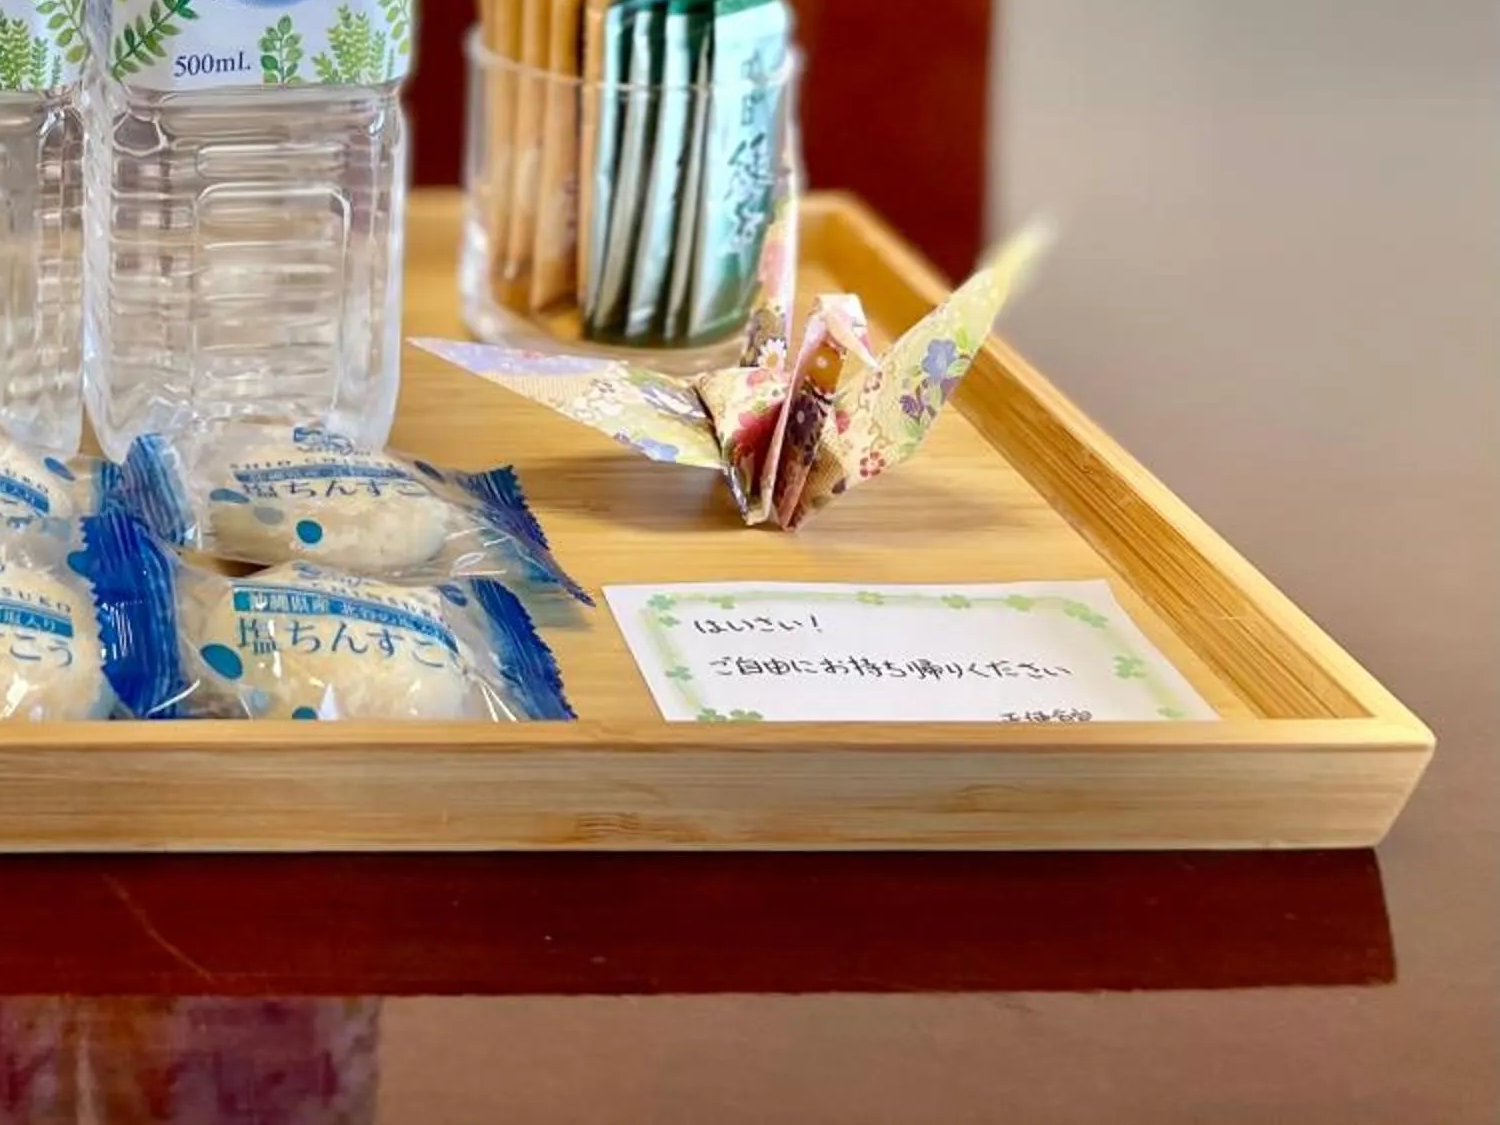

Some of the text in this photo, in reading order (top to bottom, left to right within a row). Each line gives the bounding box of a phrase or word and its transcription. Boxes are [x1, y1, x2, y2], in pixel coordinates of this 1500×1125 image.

[173, 52, 252, 78] 500mL
[237, 618, 446, 669] 塩ちんすこ
[708, 655, 1074, 681] ご自由にお持ち帰りください
